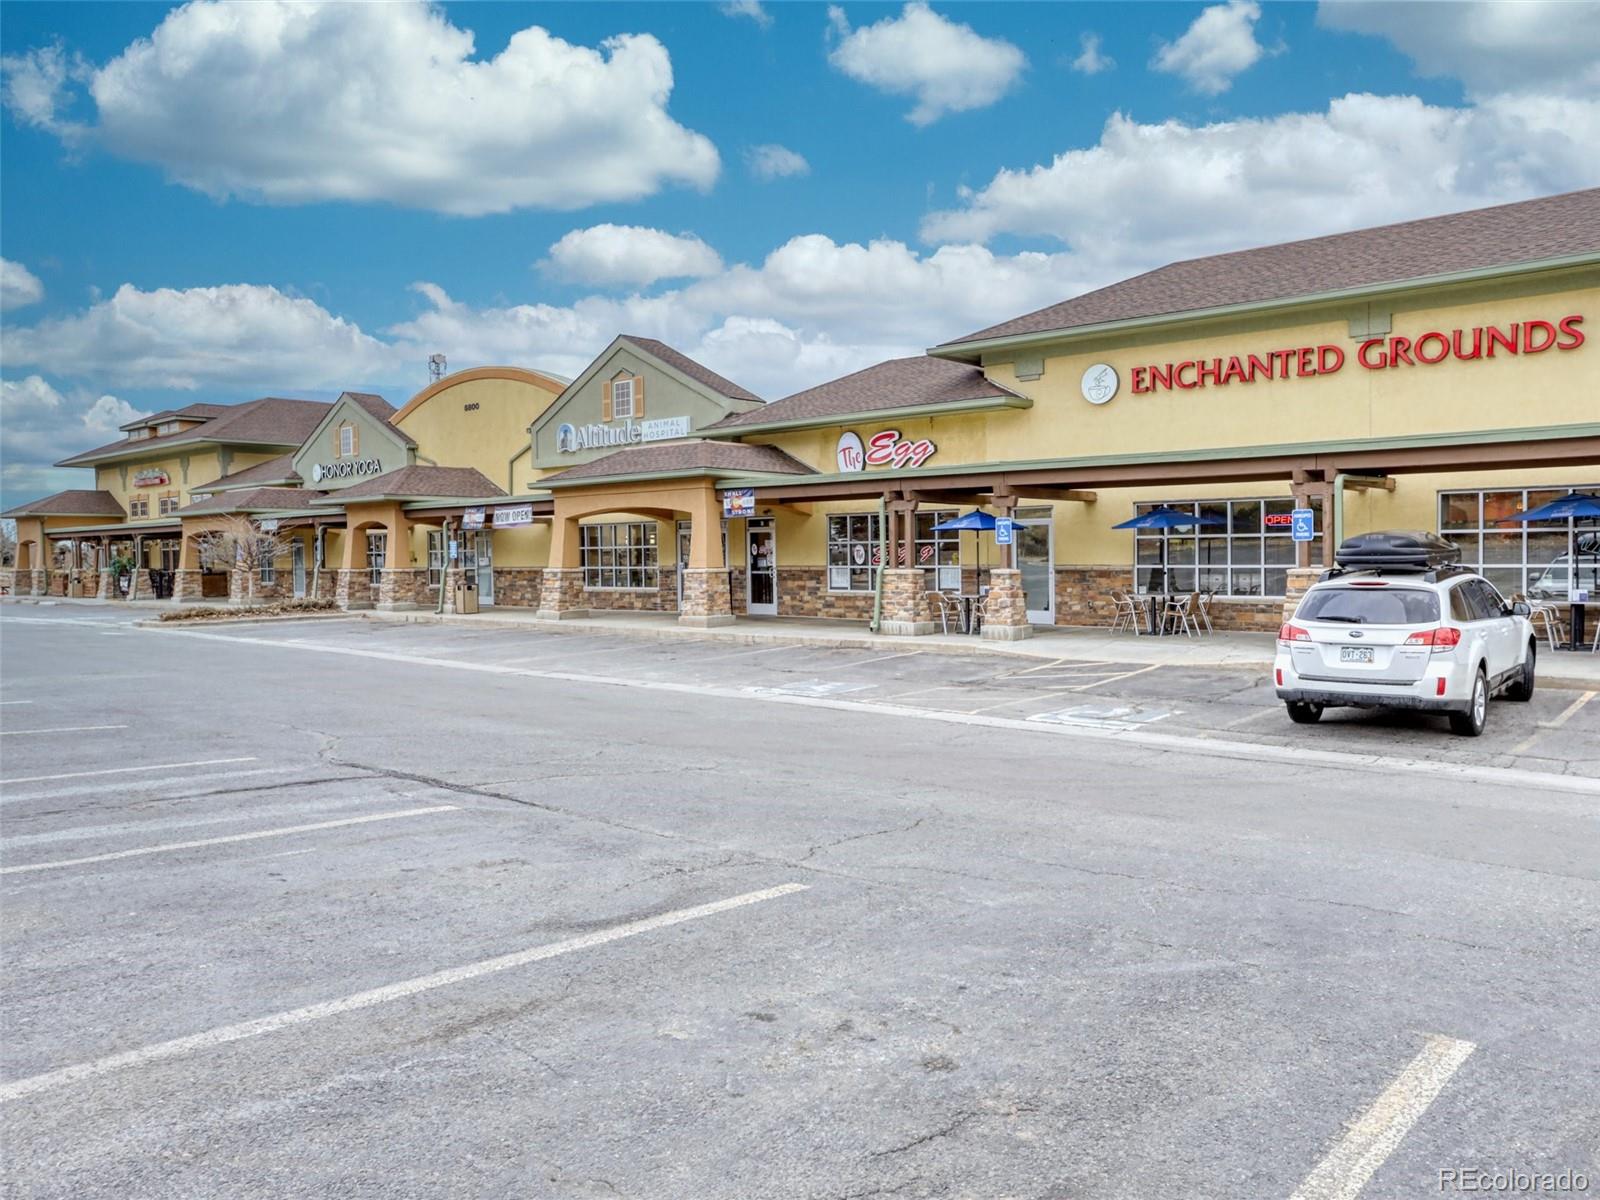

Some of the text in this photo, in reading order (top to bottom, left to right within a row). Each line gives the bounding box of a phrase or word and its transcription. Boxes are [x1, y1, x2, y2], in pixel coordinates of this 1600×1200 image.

[1131, 314, 1585, 394] ENCHANTED GROUNDS
[643, 428, 685, 439] HOSPITAL
[648, 418, 680, 429] ANIMAL
[577, 419, 641, 449] Altitude
[839, 430, 935, 470] The Egg
[321, 459, 382, 479] HONOR YOGA
[495, 511, 511, 523] NOW
